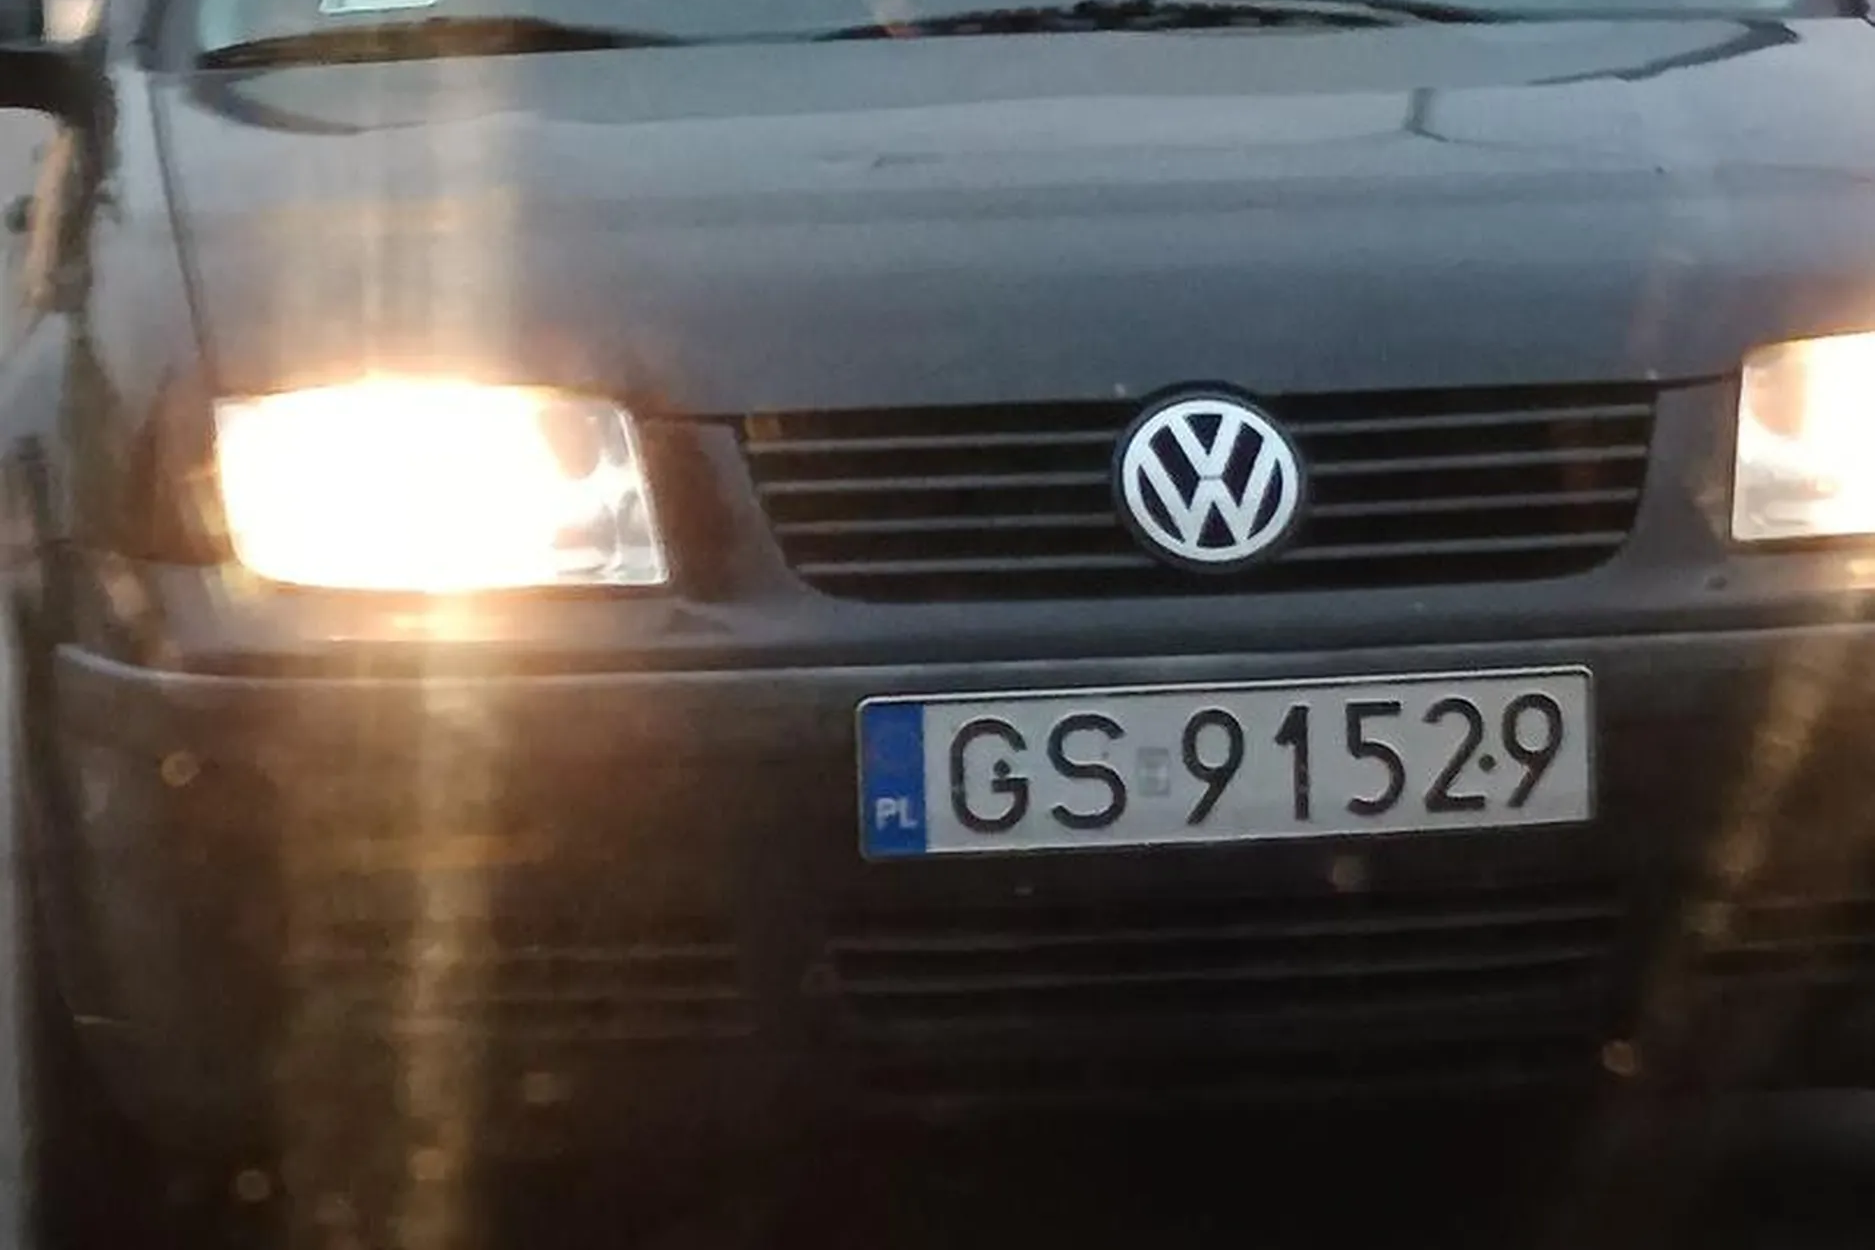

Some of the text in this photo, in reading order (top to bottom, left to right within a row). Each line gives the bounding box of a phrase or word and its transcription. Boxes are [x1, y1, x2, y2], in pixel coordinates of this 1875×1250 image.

[1124, 401, 1297, 560] VW
[875, 797, 918, 831] PL
[950, 693, 1563, 833] GS 91529
